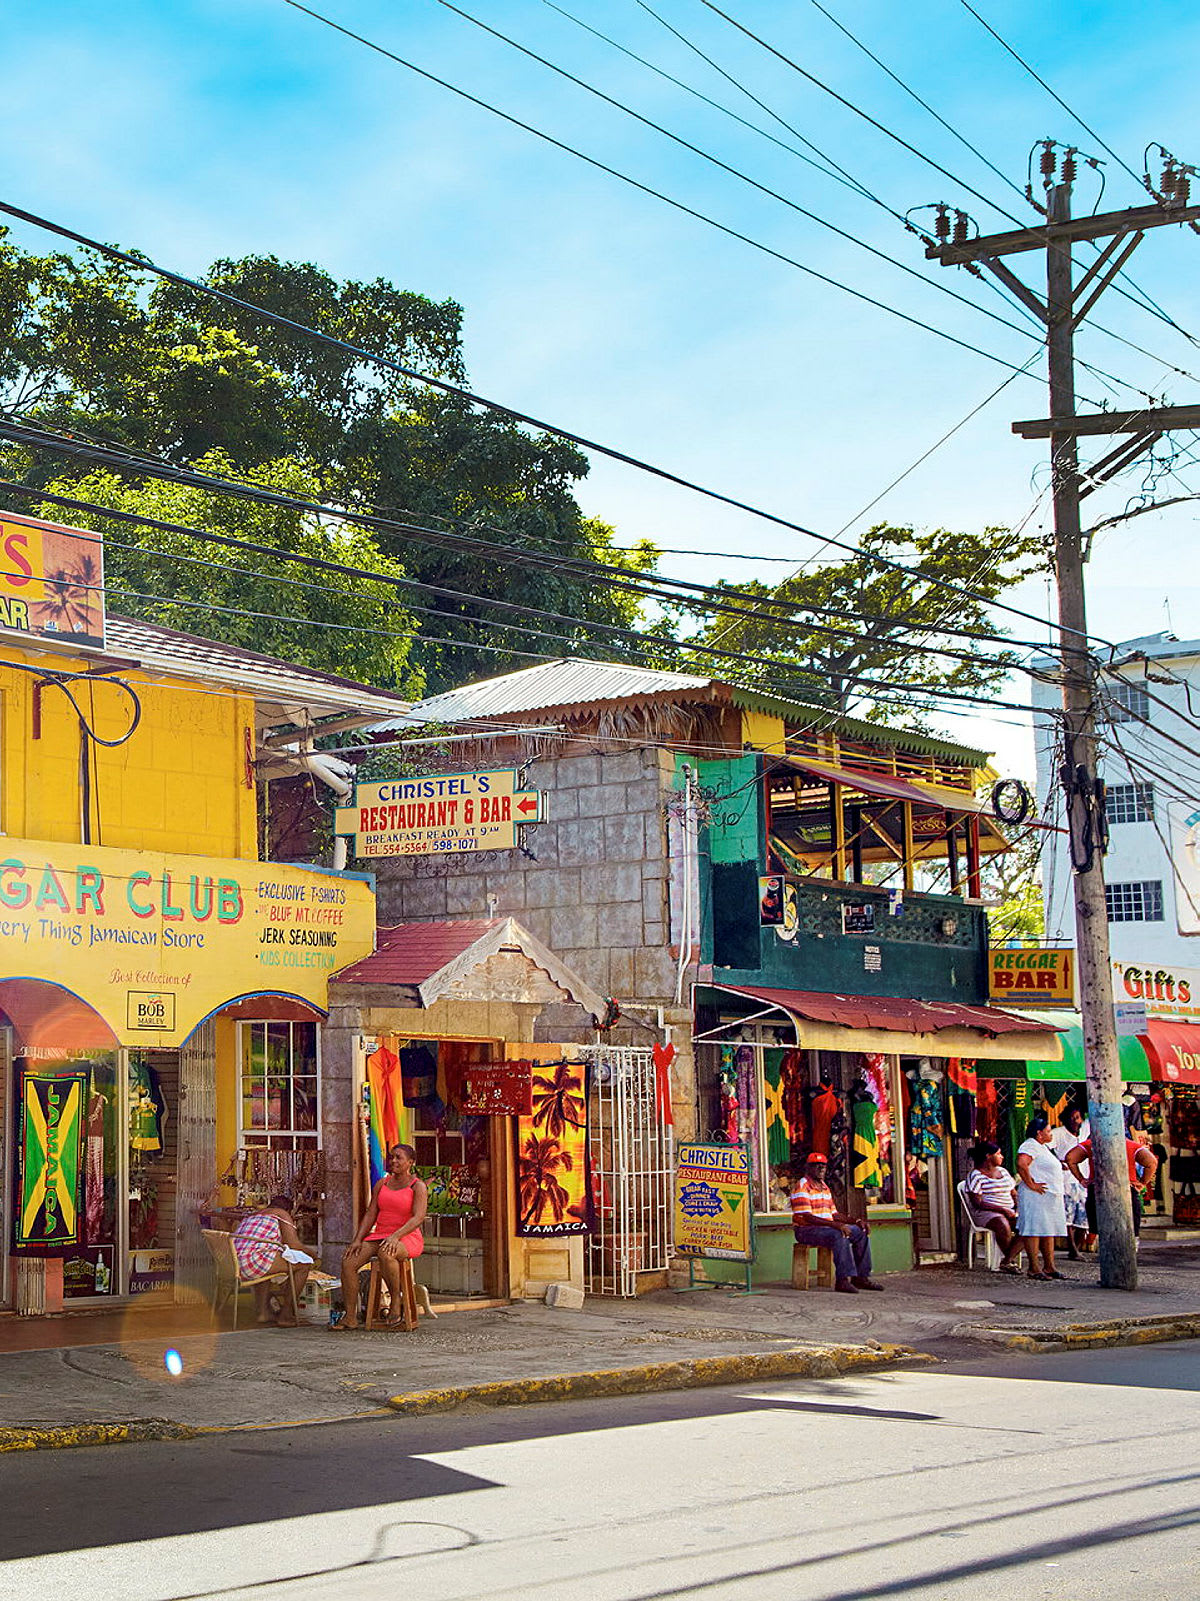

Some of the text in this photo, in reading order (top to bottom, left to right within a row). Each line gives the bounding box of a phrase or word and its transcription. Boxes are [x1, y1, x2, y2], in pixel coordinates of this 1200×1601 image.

[378, 774, 491, 802] CHRISTEL'S
[360, 796, 512, 833] RESTAURANT & BAR
[365, 831, 423, 845] BREAKFAST
[426, 828, 460, 840] READY
[465, 827, 476, 837] AT
[125, 869, 245, 926] CLUB
[259, 881, 346, 905] EXCLUSIVE T-SHIRTS
[39, 919, 83, 946] Thing
[88, 926, 158, 949] Jamaican
[162, 930, 206, 949] Store
[260, 928, 337, 947] JERK SEASONING
[260, 950, 336, 969] KIDS COLLECTION
[993, 952, 1059, 969] REGGAE
[109, 968, 133, 985] Best
[136, 970, 179, 984] Collection
[993, 971, 1058, 989] BAR
[1123, 966, 1191, 1003] Gifts
[138, 1003, 165, 1017] BOB
[137, 1017, 165, 1025] MARLEY
[45, 1084, 61, 1235] JAMAICA
[680, 1148, 747, 1169] CHRISTEL'S
[523, 1222, 588, 1233] JAMAICA
[131, 1280, 171, 1292] BACARDI
